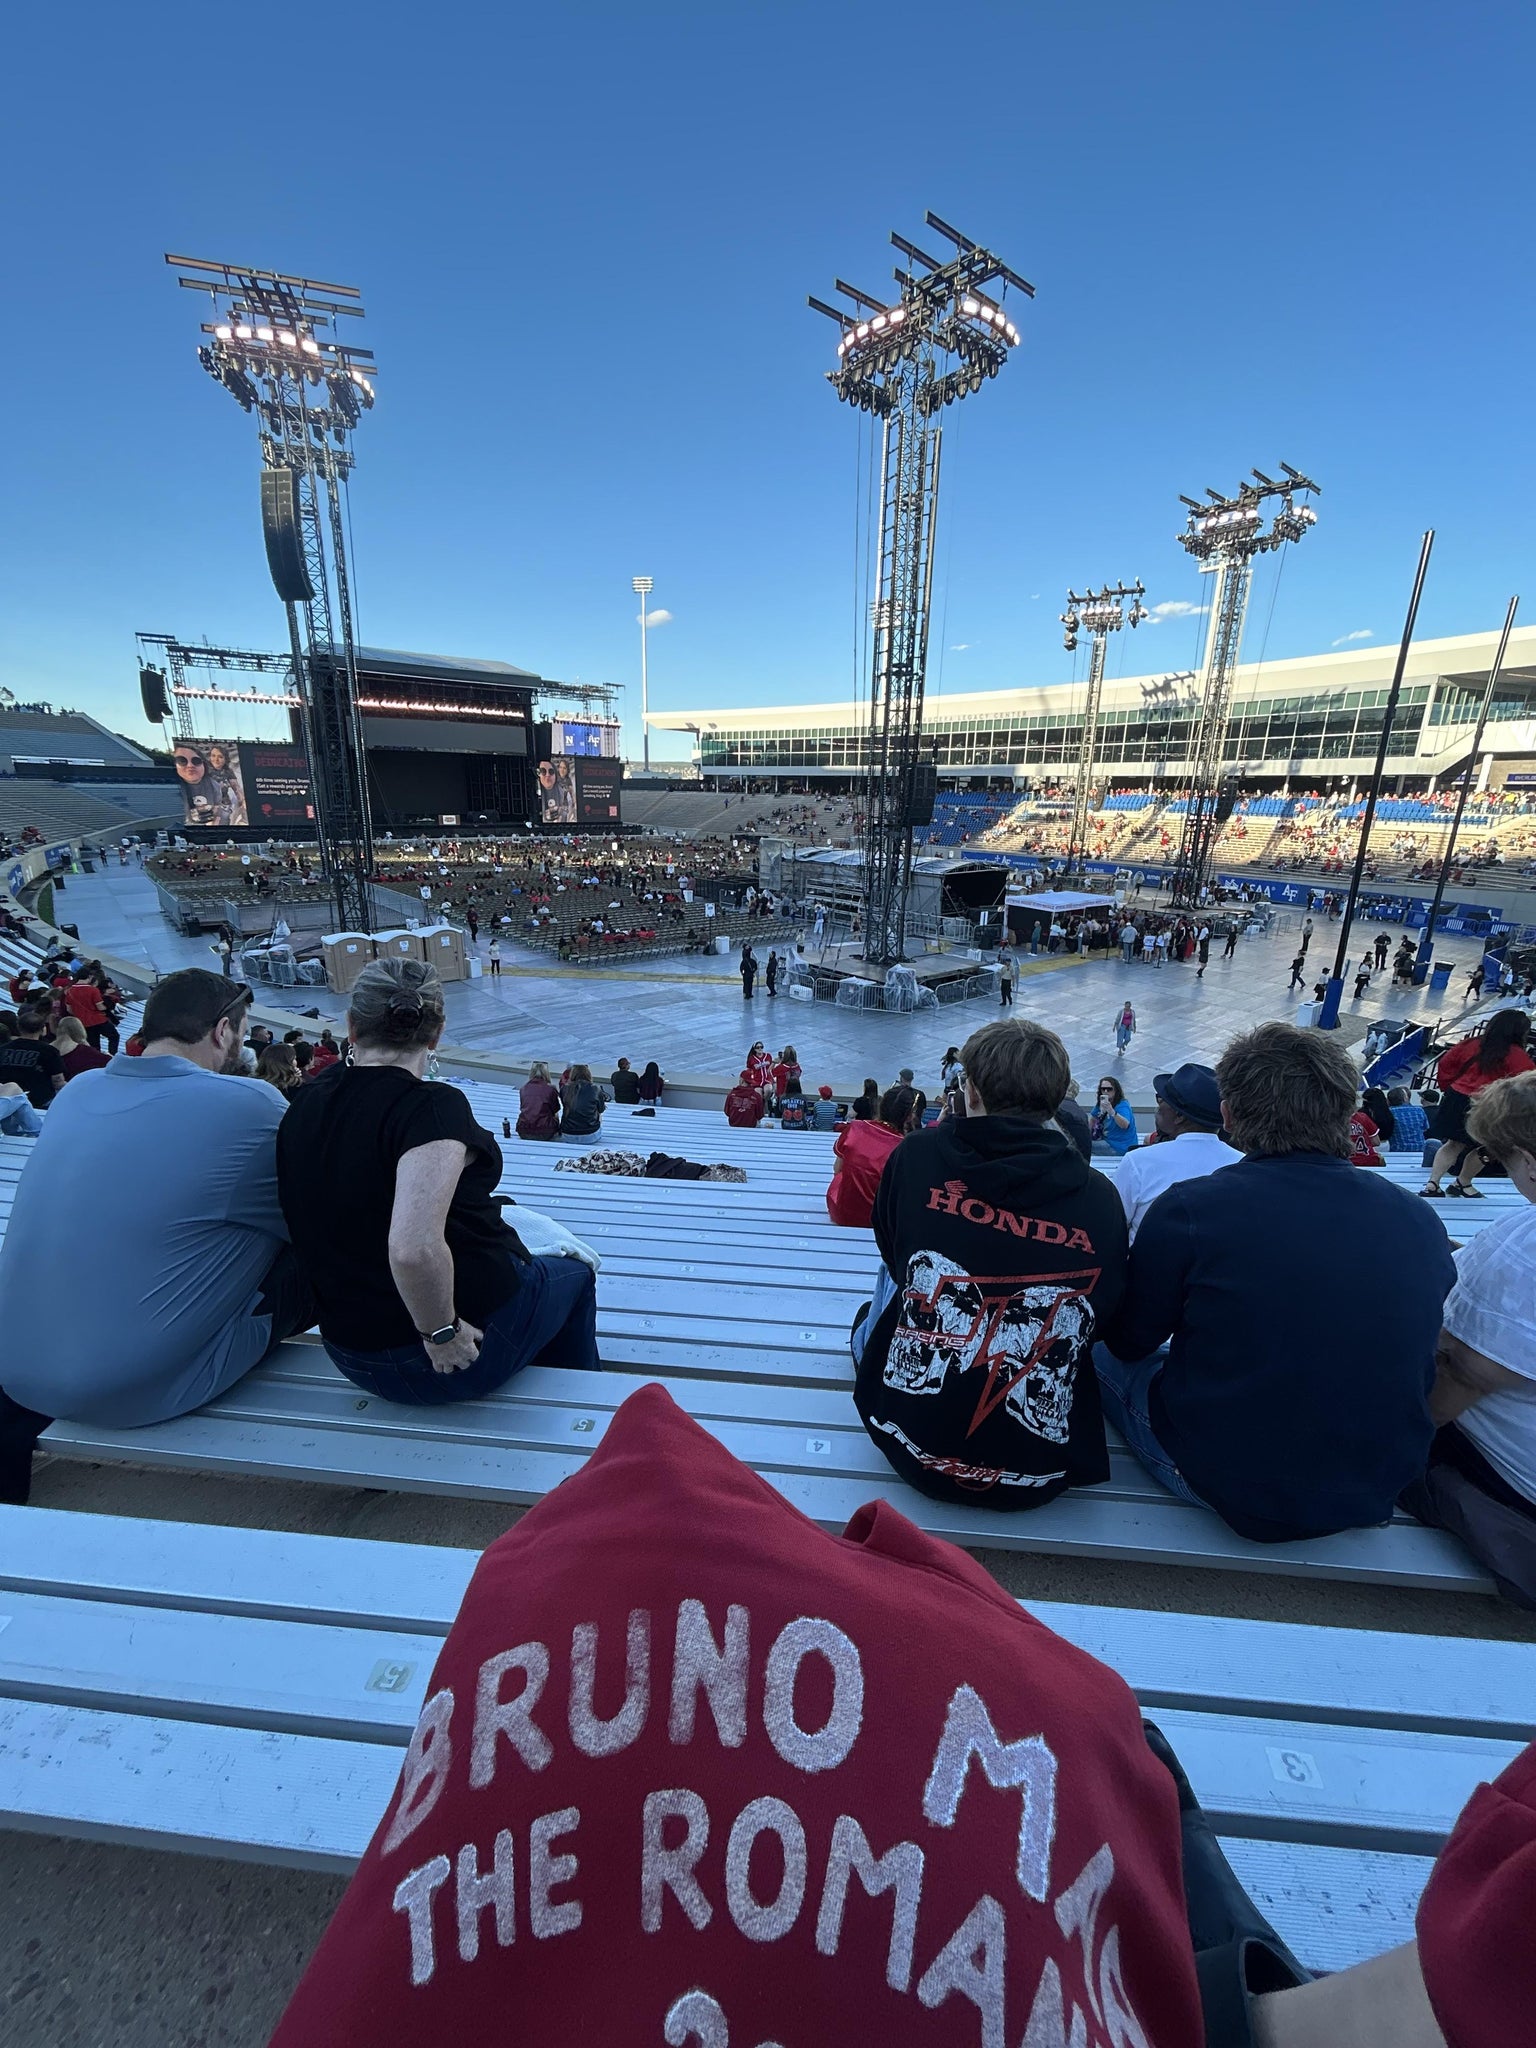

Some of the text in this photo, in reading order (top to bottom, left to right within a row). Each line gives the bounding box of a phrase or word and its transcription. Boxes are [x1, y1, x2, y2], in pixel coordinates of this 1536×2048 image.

[994, 710, 1027, 718] CENTER
[1282, 884, 1298, 902] AF
[926, 1185, 1096, 1255] HONDA
[895, 1326, 967, 1349] RACING
[813, 1440, 824, 1452] 4
[381, 1598, 865, 1859] BRUNO
[1281, 1751, 1306, 1782] 3
[393, 1806, 585, 1987] THE
